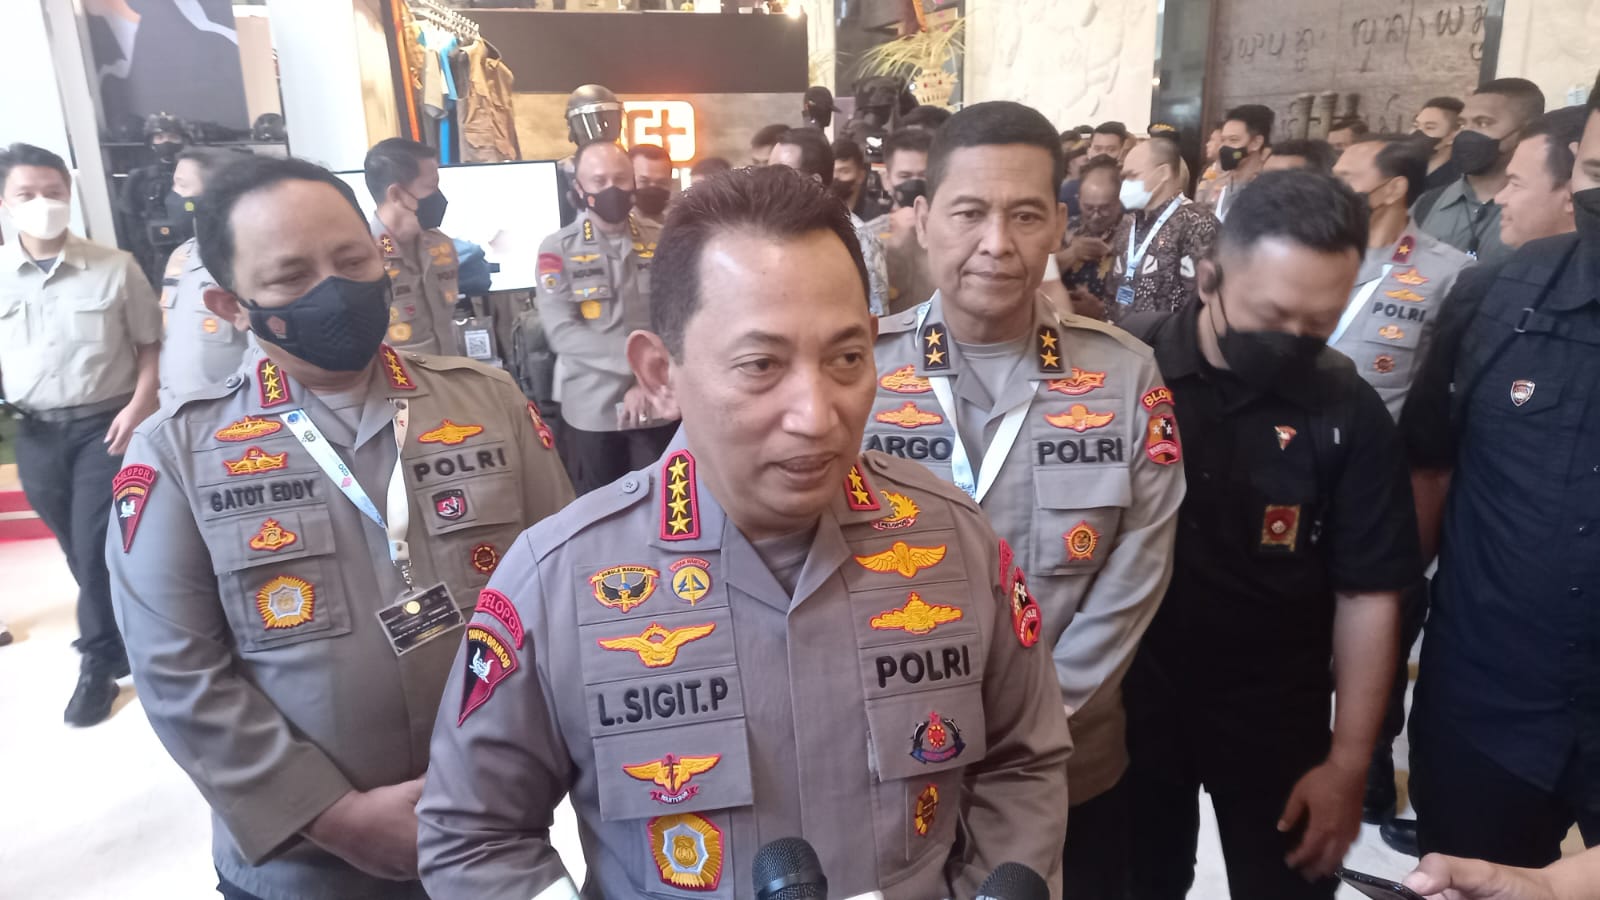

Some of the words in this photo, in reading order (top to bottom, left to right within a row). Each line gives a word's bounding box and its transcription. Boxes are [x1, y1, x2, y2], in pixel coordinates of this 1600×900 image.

[1372, 302, 1426, 322] POLRI
[866, 434, 954, 460] ARGO
[1037, 437, 1123, 465] POLRI
[413, 448, 506, 482] POLRI
[211, 485, 264, 512] GATOT
[270, 479, 314, 502] EDDY
[875, 645, 970, 688] POLRI
[598, 677, 728, 726] L.SIGIT.P
